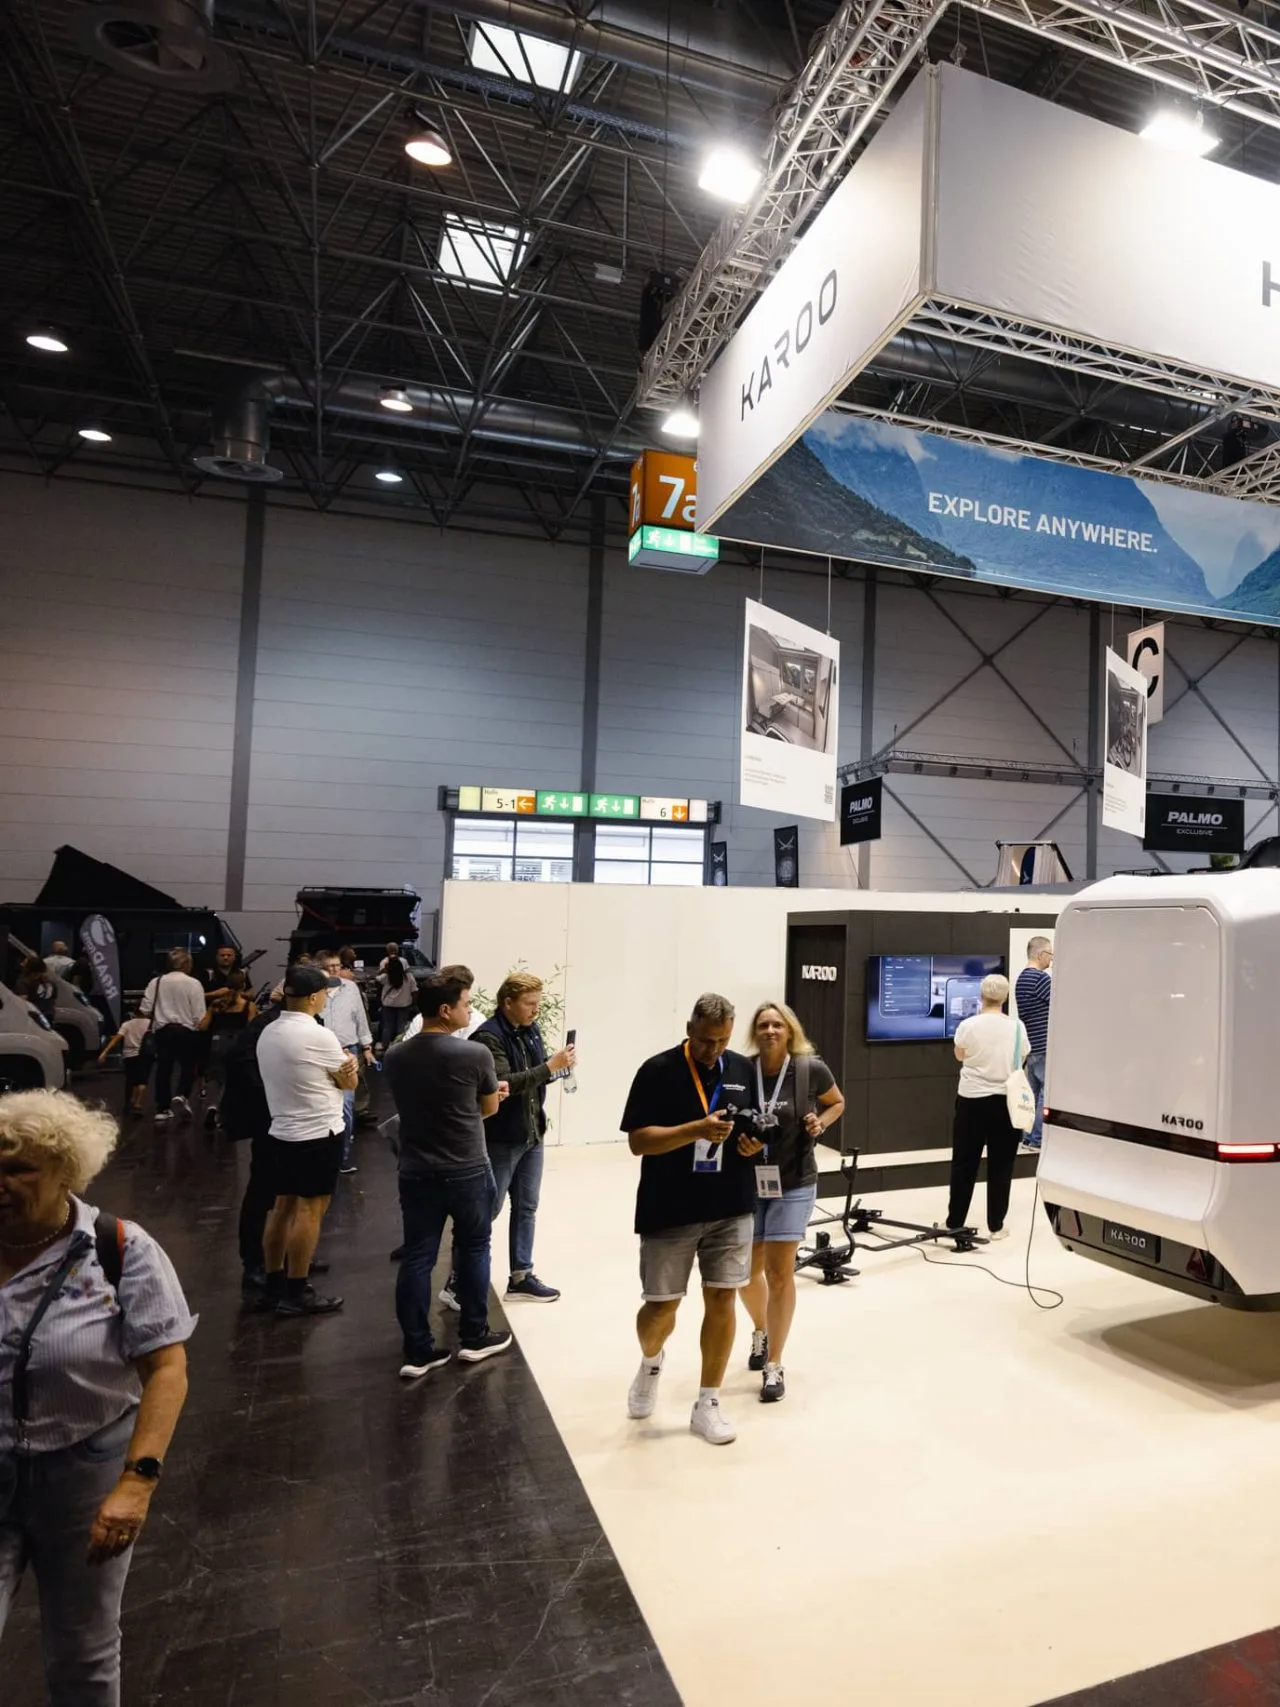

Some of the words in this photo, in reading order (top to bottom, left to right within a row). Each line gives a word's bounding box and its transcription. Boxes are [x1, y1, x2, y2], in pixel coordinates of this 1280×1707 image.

[741, 269, 838, 422] KAROO
[659, 475, 697, 523] 7a
[928, 491, 1031, 531] EXPLORE
[1036, 513, 1158, 553] ANYWHERE.
[660, 807, 667, 818] 6
[849, 796, 873, 814] PALMO
[1167, 810, 1223, 825] PALMO
[1176, 828, 1213, 837] EXCLUSIVE
[801, 964, 837, 982] KAROO
[1161, 1113, 1204, 1131] KAROO
[1110, 1228, 1146, 1248] KAROO
